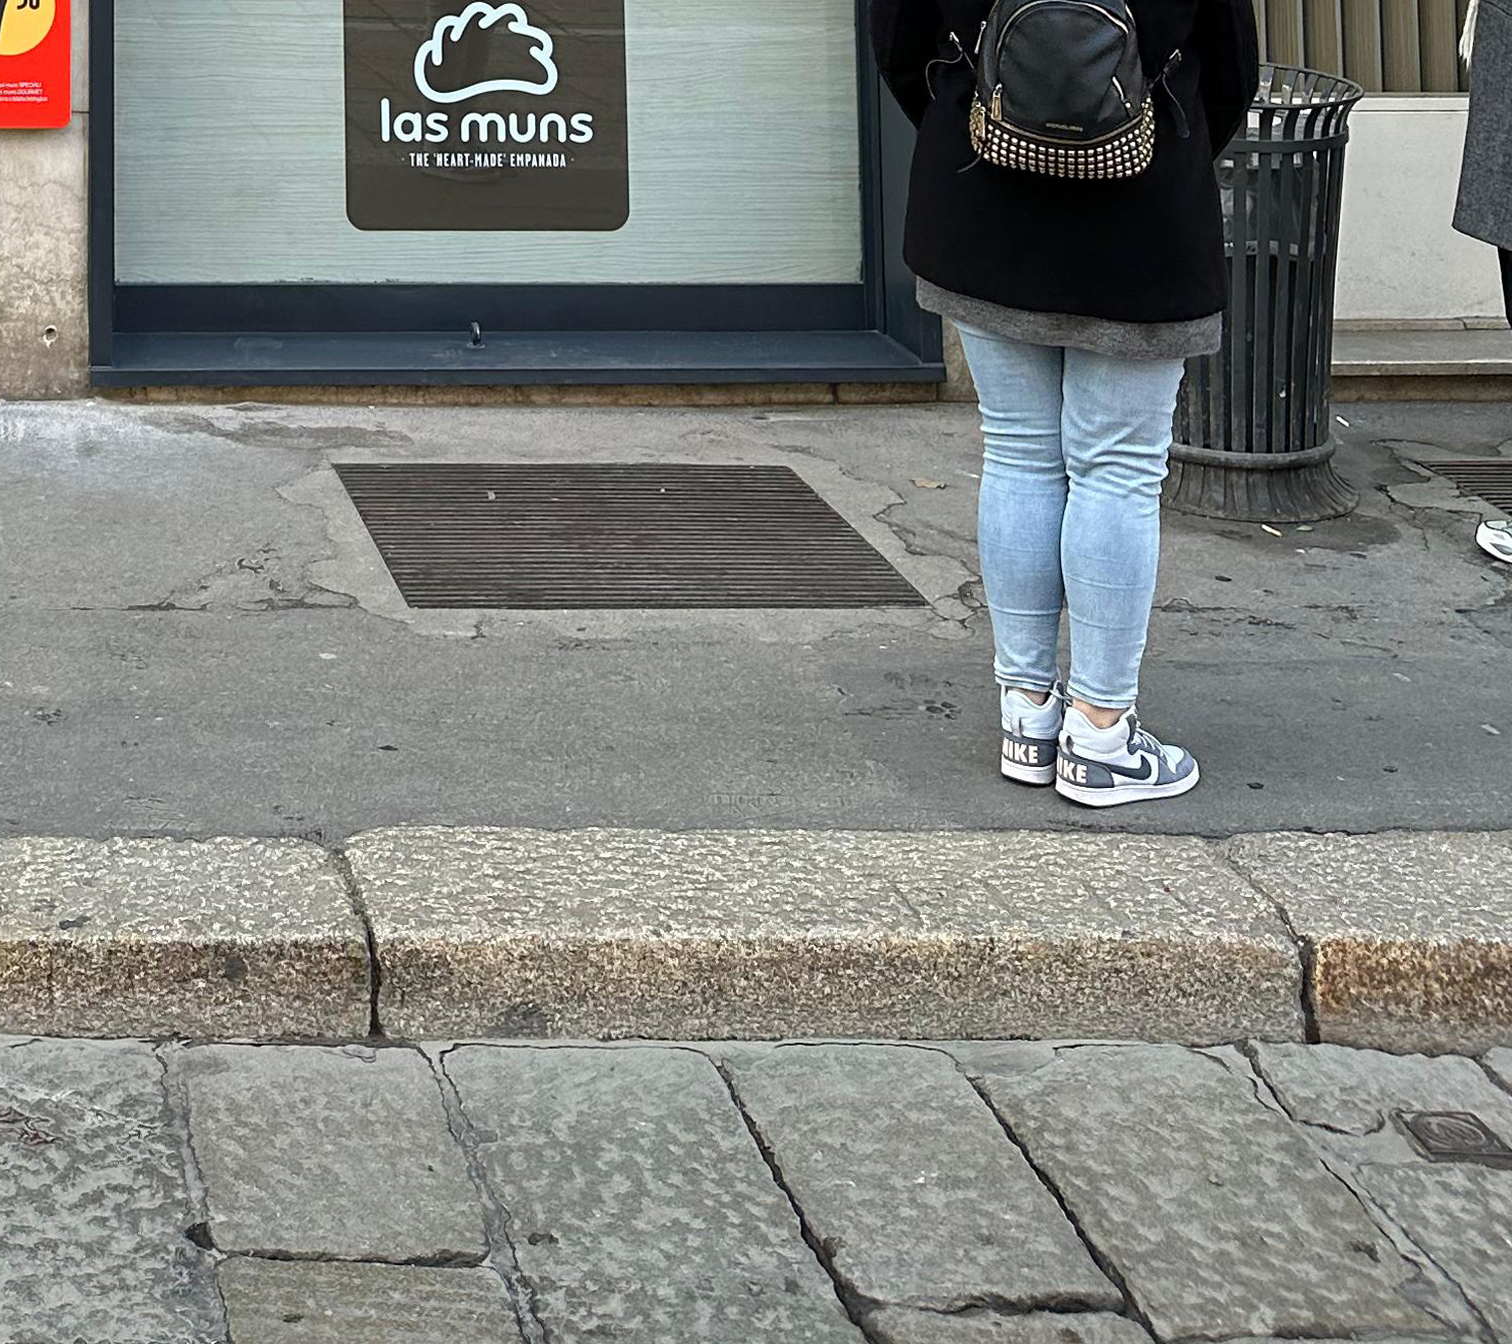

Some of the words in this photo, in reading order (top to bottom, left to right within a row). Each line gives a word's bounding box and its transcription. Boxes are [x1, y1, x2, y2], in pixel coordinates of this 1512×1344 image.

[380, 97, 450, 143] las
[460, 112, 595, 144] muns
[409, 152, 429, 168] THE
[433, 152, 507, 168] 'HEART-MADE'
[510, 152, 567, 168] EMPANADA
